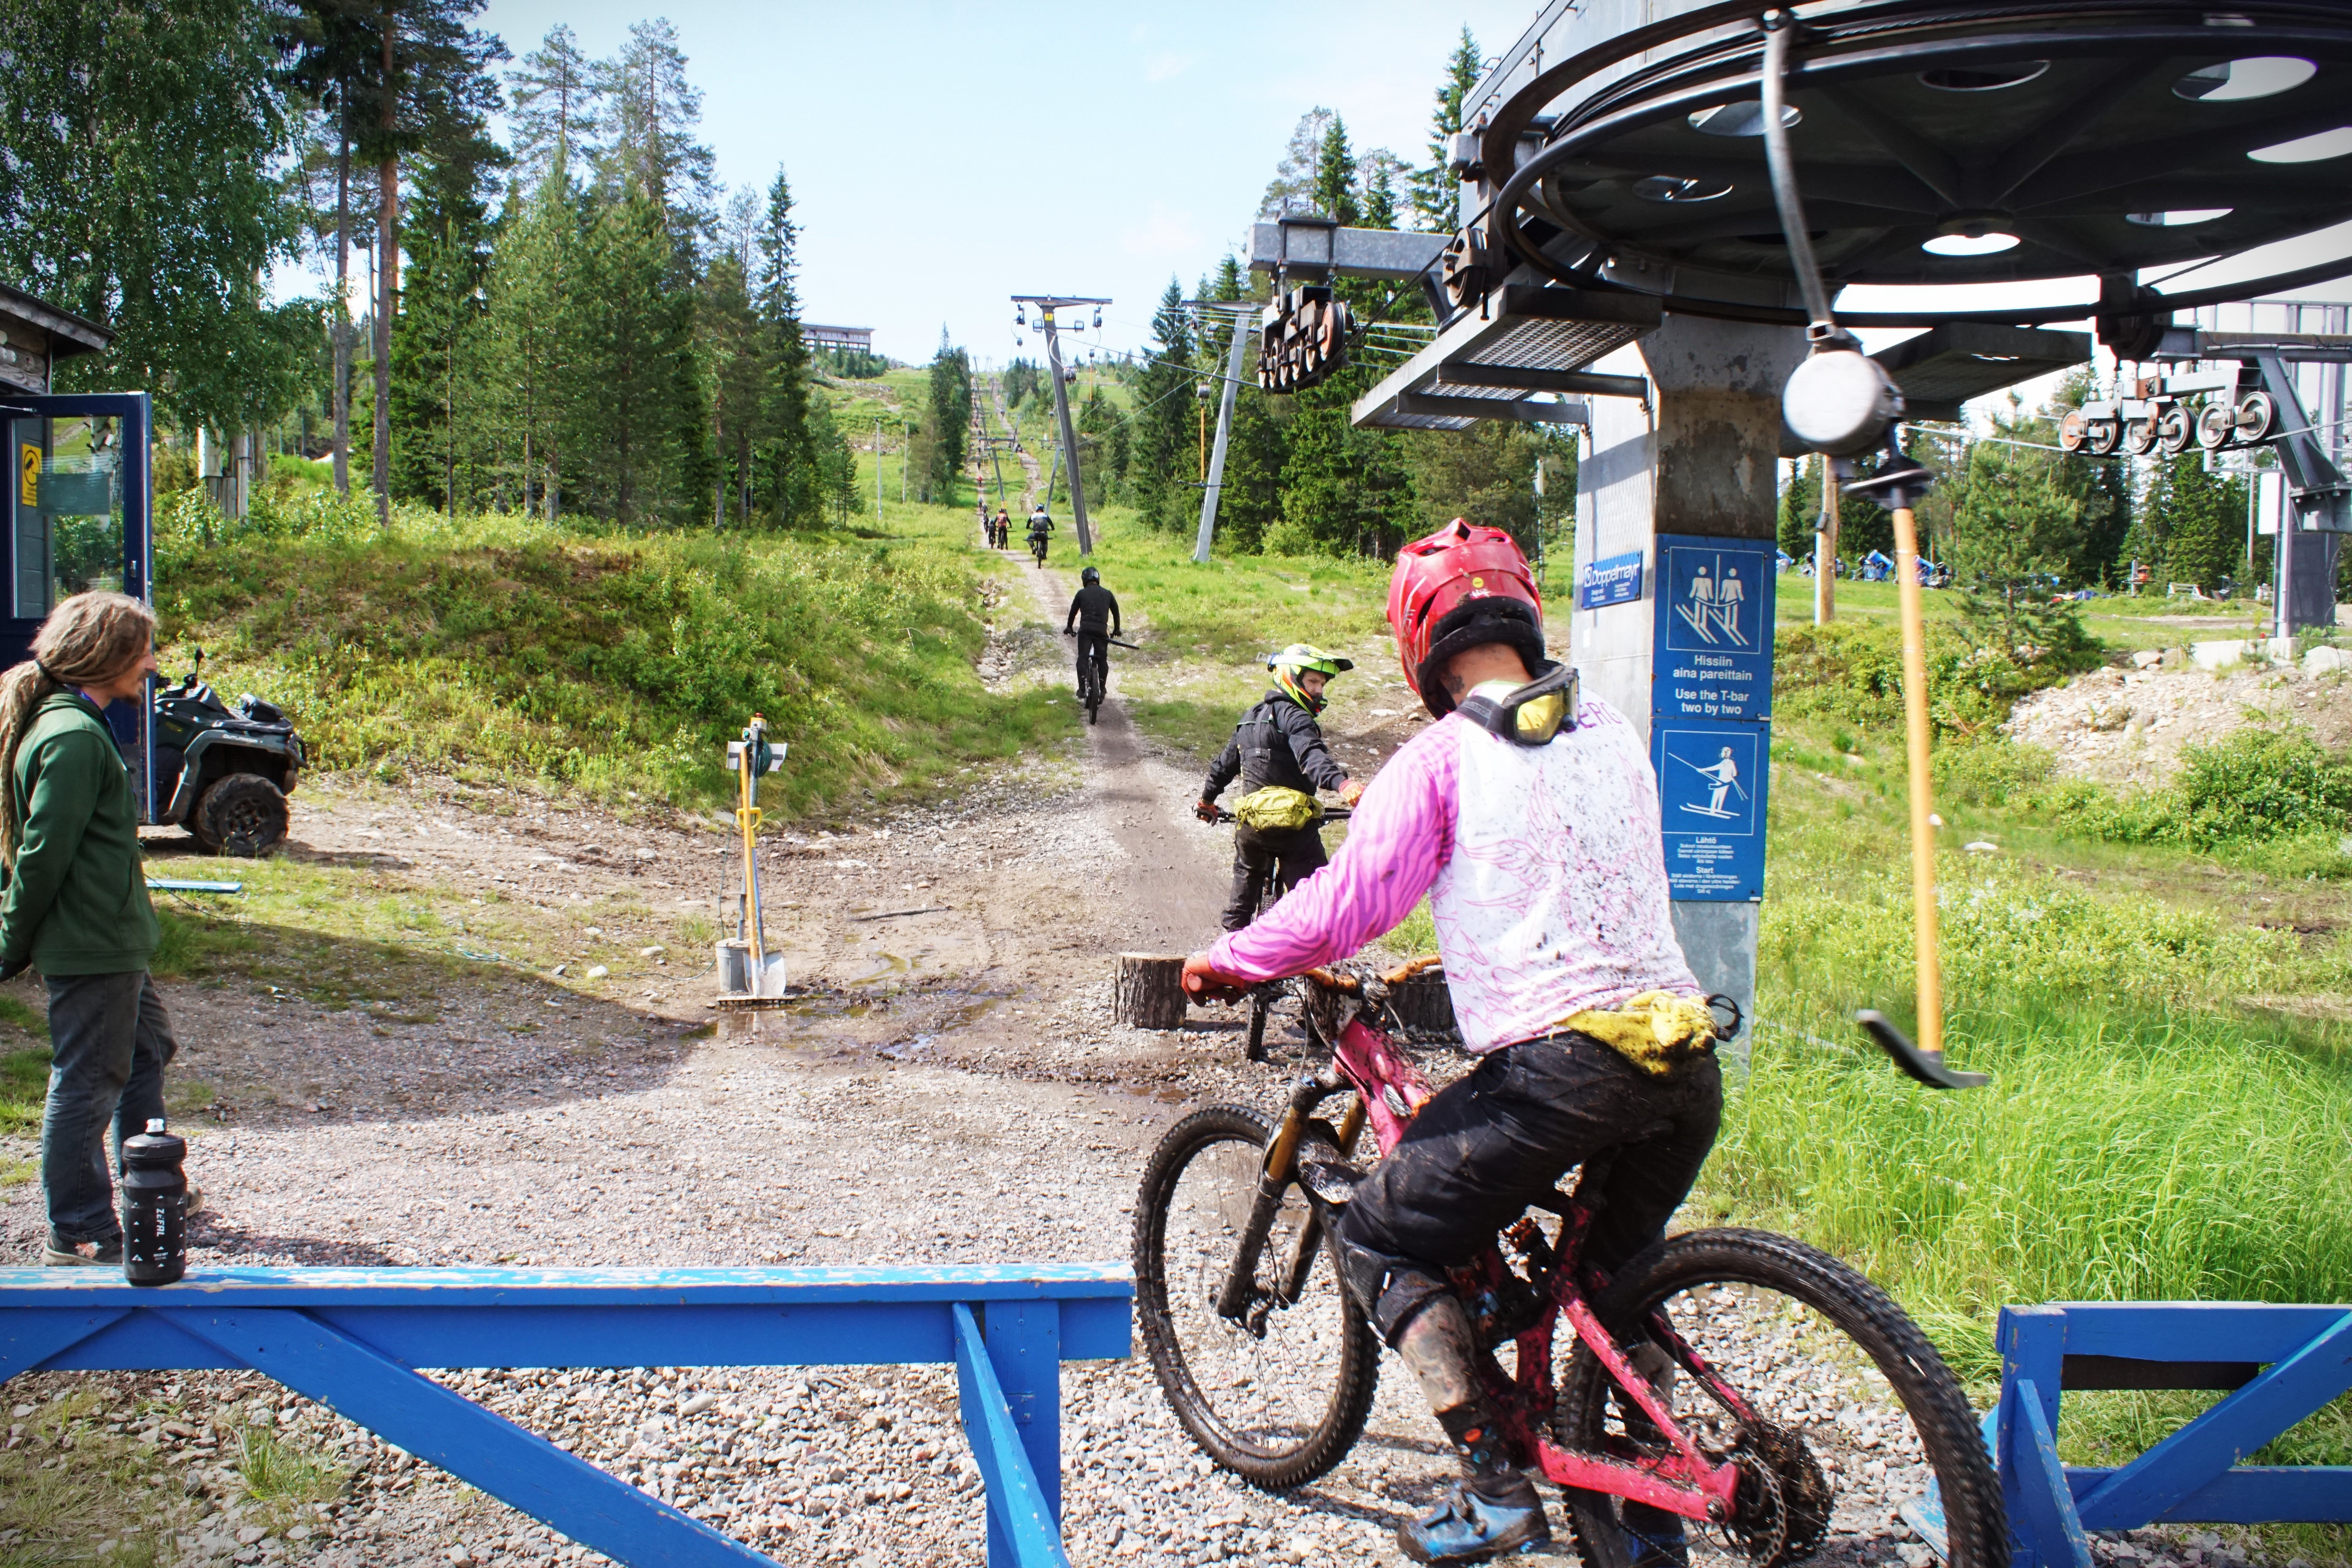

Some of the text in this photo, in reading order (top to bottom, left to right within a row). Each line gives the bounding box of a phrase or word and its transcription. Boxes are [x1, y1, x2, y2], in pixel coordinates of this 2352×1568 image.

[1592, 563, 1641, 588] Doppelmayr
[1694, 655, 1733, 666] Hissiin
[1673, 667, 1753, 681] aina pareittain
[1675, 688, 1750, 702] Use the T-bar
[1681, 702, 1742, 716] two by two
